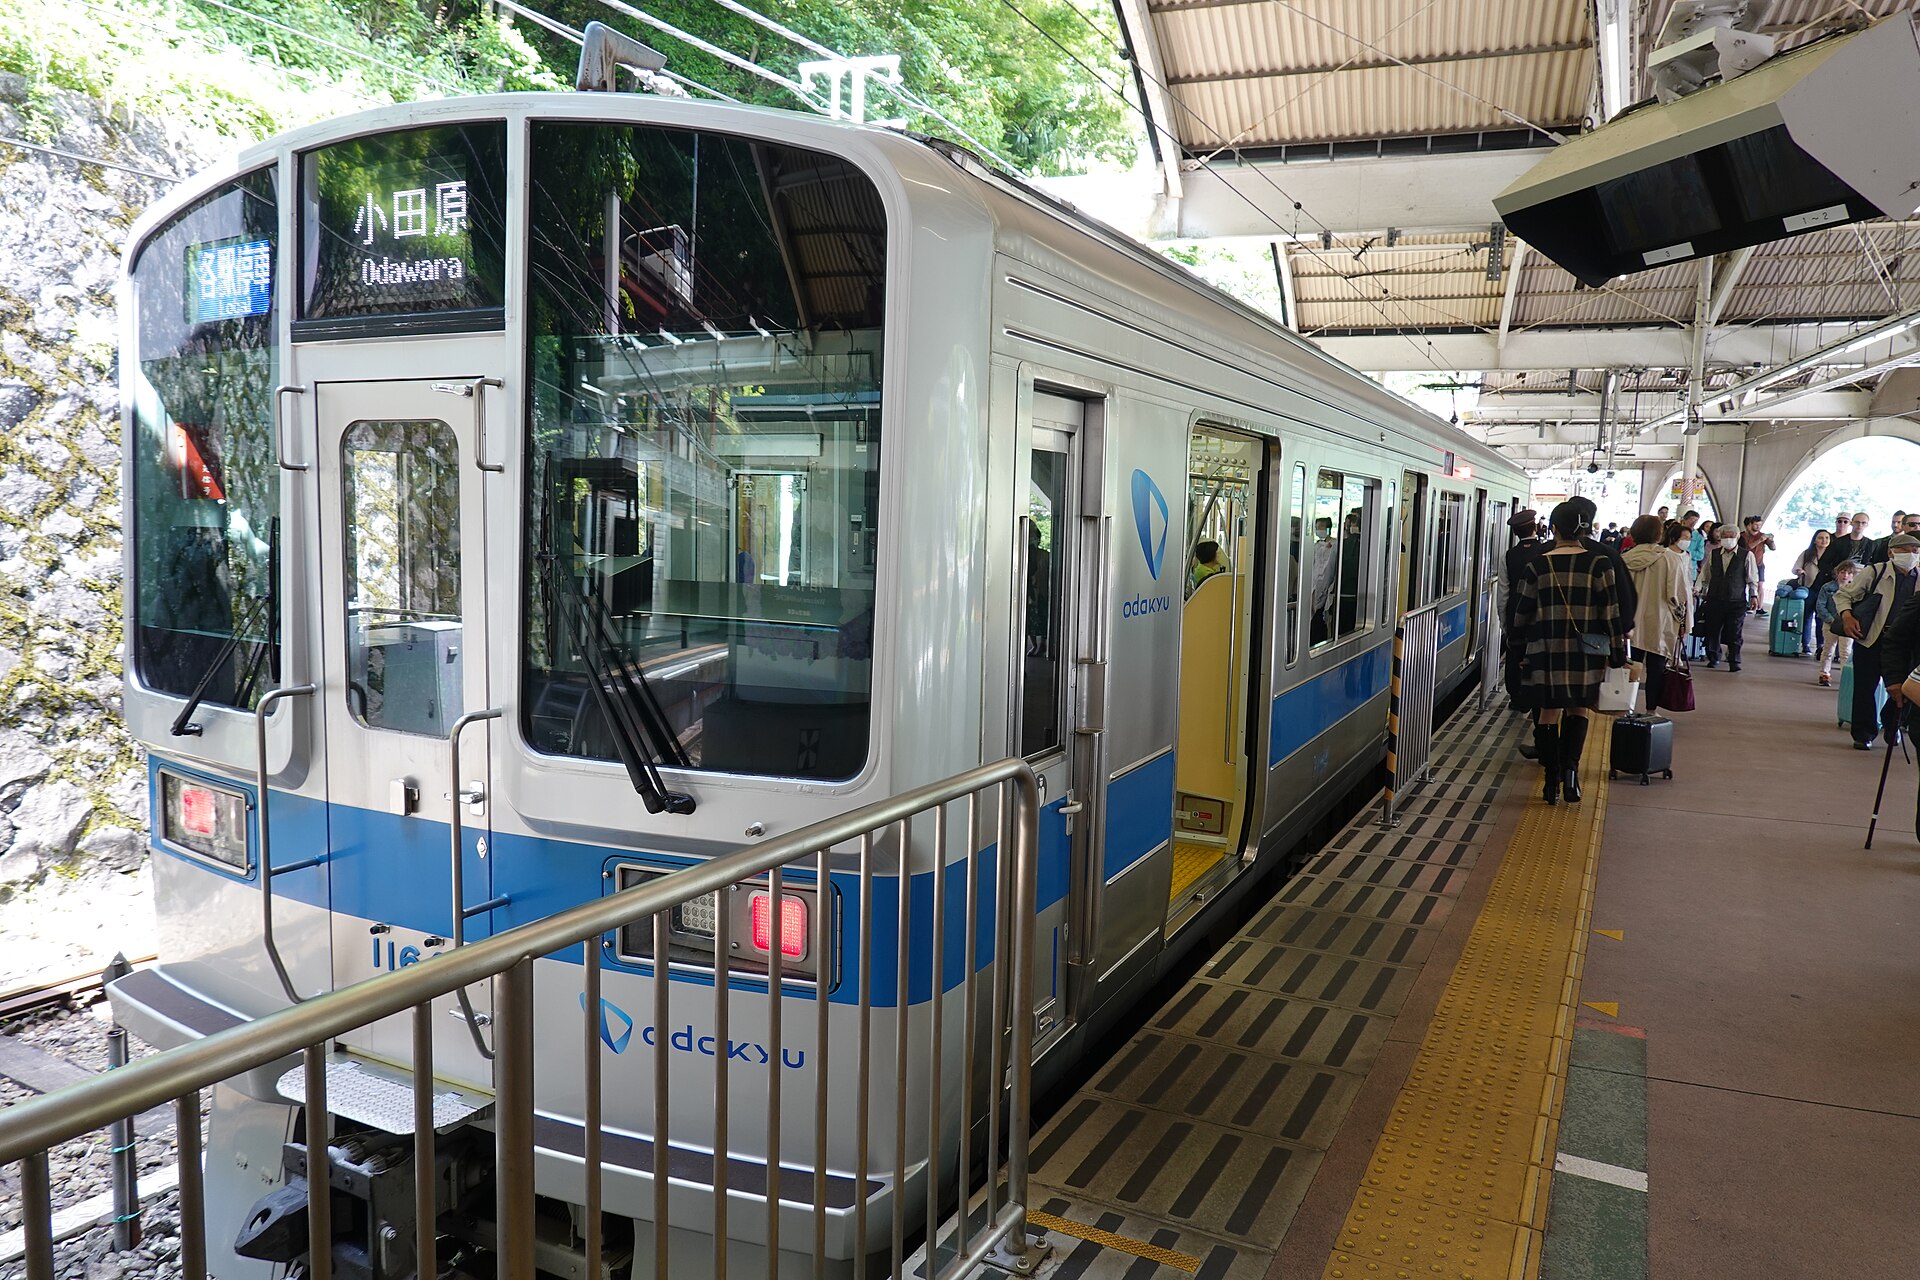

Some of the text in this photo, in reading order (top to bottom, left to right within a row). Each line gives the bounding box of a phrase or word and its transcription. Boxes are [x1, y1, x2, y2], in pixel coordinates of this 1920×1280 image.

[353, 180, 467, 246] 小田原
[1665, 250, 1671, 258] 3
[198, 242, 270, 299] 各駅停車
[361, 256, 463, 286] Odawara
[218, 295, 253, 315] Local
[1122, 592, 1170, 619] odakyu
[372, 937, 444, 972] 116
